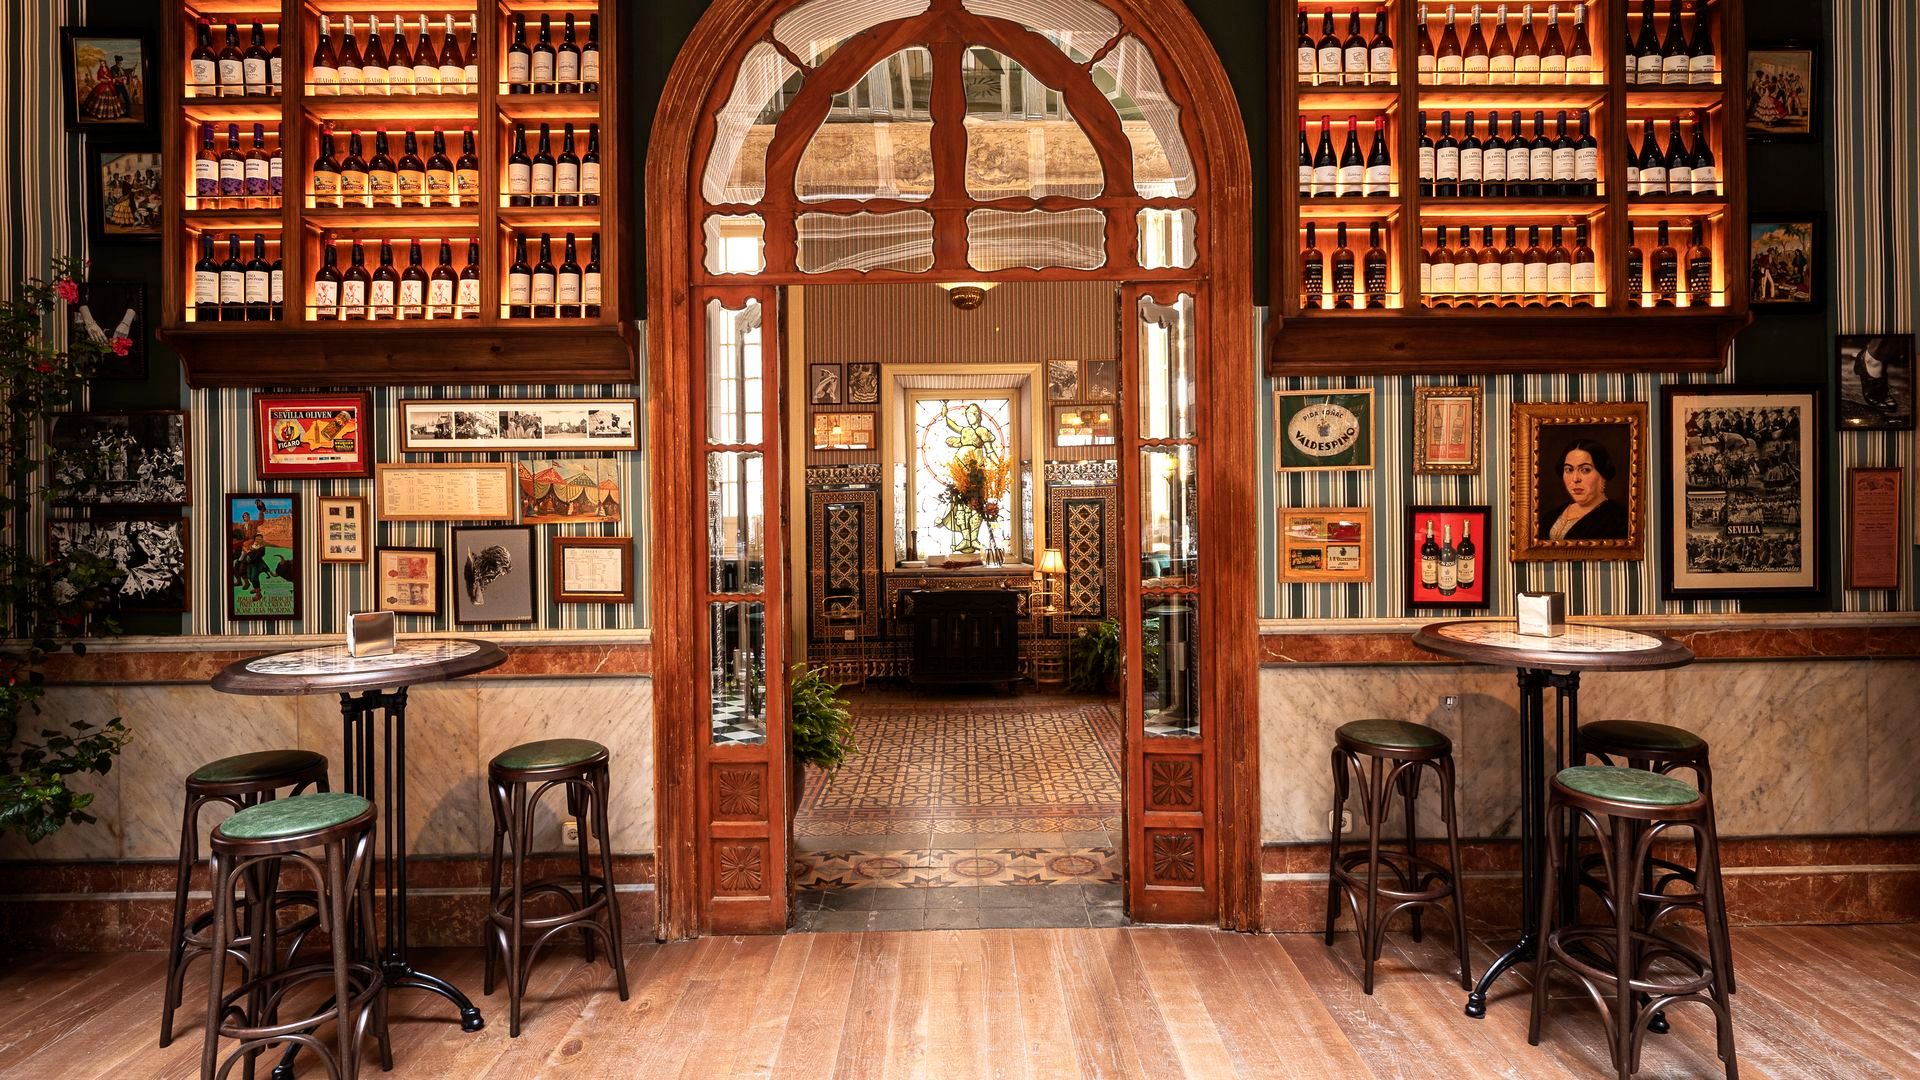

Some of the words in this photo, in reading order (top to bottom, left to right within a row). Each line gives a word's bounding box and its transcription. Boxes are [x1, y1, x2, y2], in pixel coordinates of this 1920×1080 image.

[273, 411, 304, 419] SEVILLA
[305, 411, 332, 419] OLIVEN
[1303, 411, 1319, 421] PIDA
[1295, 427, 1355, 451] VALDESPINO
[278, 439, 300, 450] FIGARO
[1727, 525, 1761, 534] SEVILLA
